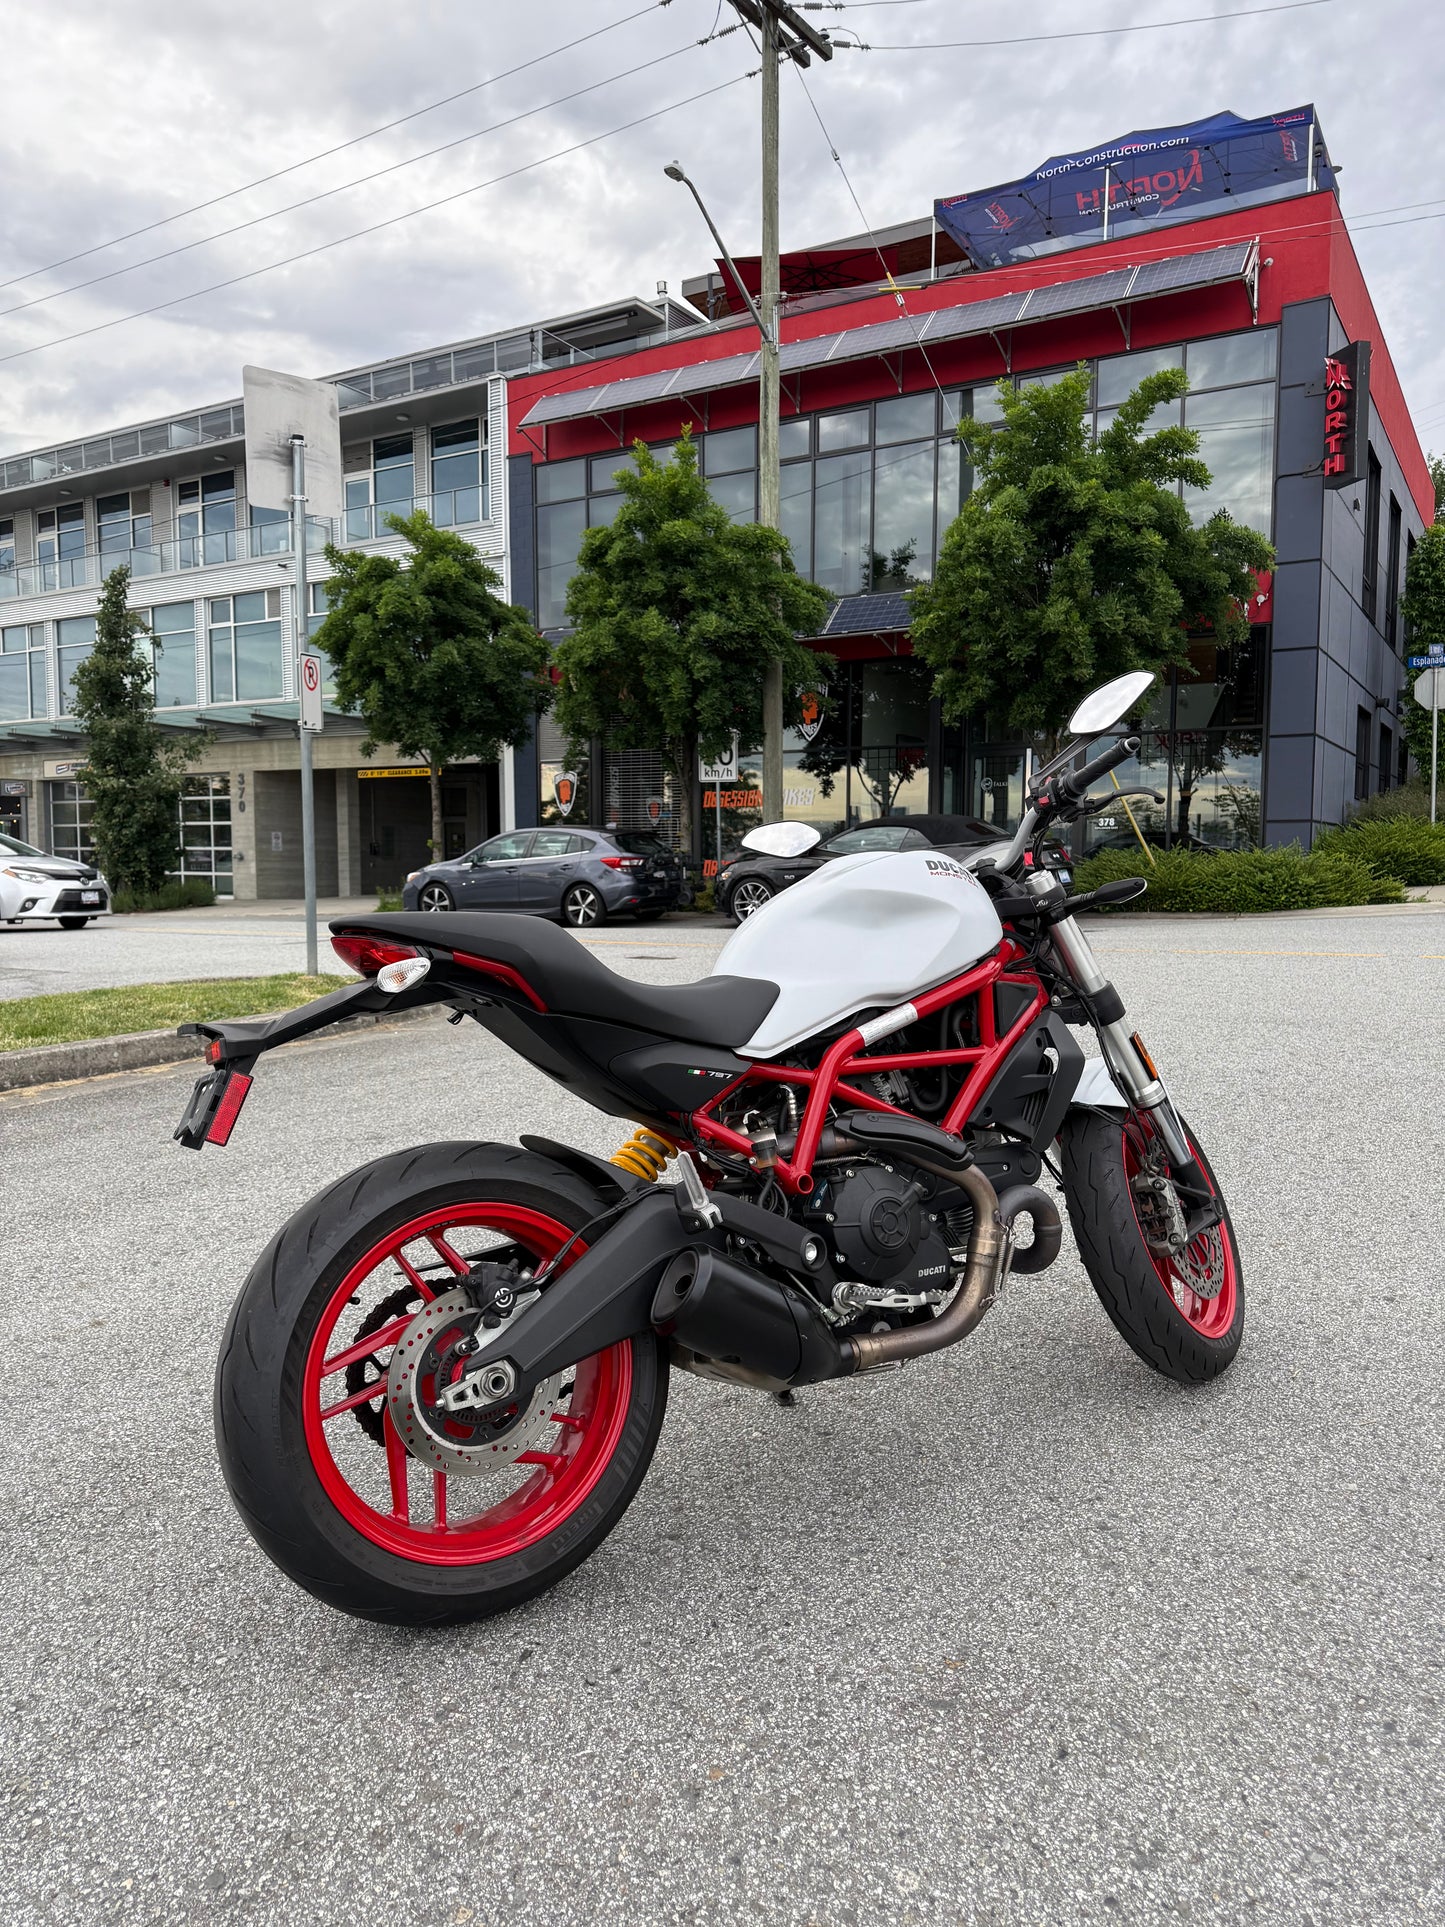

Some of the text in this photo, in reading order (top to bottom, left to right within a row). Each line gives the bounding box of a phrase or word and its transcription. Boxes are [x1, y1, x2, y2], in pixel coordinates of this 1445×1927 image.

[1324, 357, 1352, 477] NORTH
[1412, 655, 1445, 667] Esplanad
[704, 767, 733, 778] km/h
[238, 773, 246, 813] 370
[783, 787, 815, 806] IKES
[1098, 817, 1115, 827] 378
[707, 1070, 733, 1079] 797
[918, 1264, 946, 1278] DUCATI
